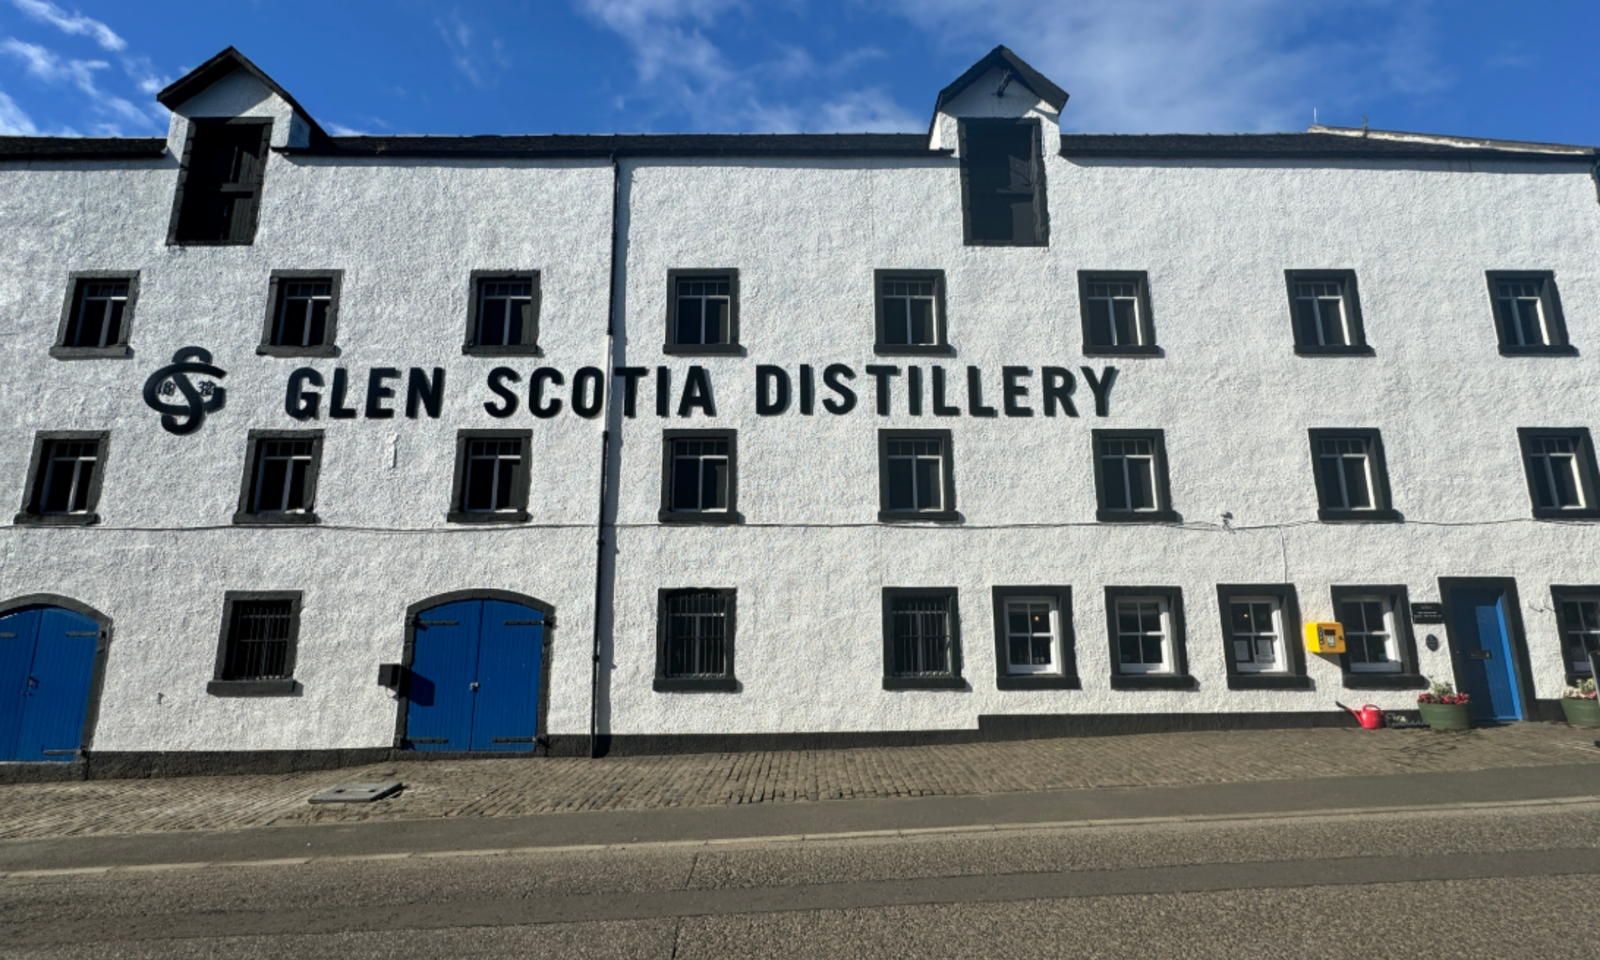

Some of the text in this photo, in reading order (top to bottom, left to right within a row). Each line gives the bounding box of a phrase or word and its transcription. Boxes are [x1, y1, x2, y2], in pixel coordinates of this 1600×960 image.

[286, 363, 1119, 419] GLEN SCOTIA DISTILLERY
